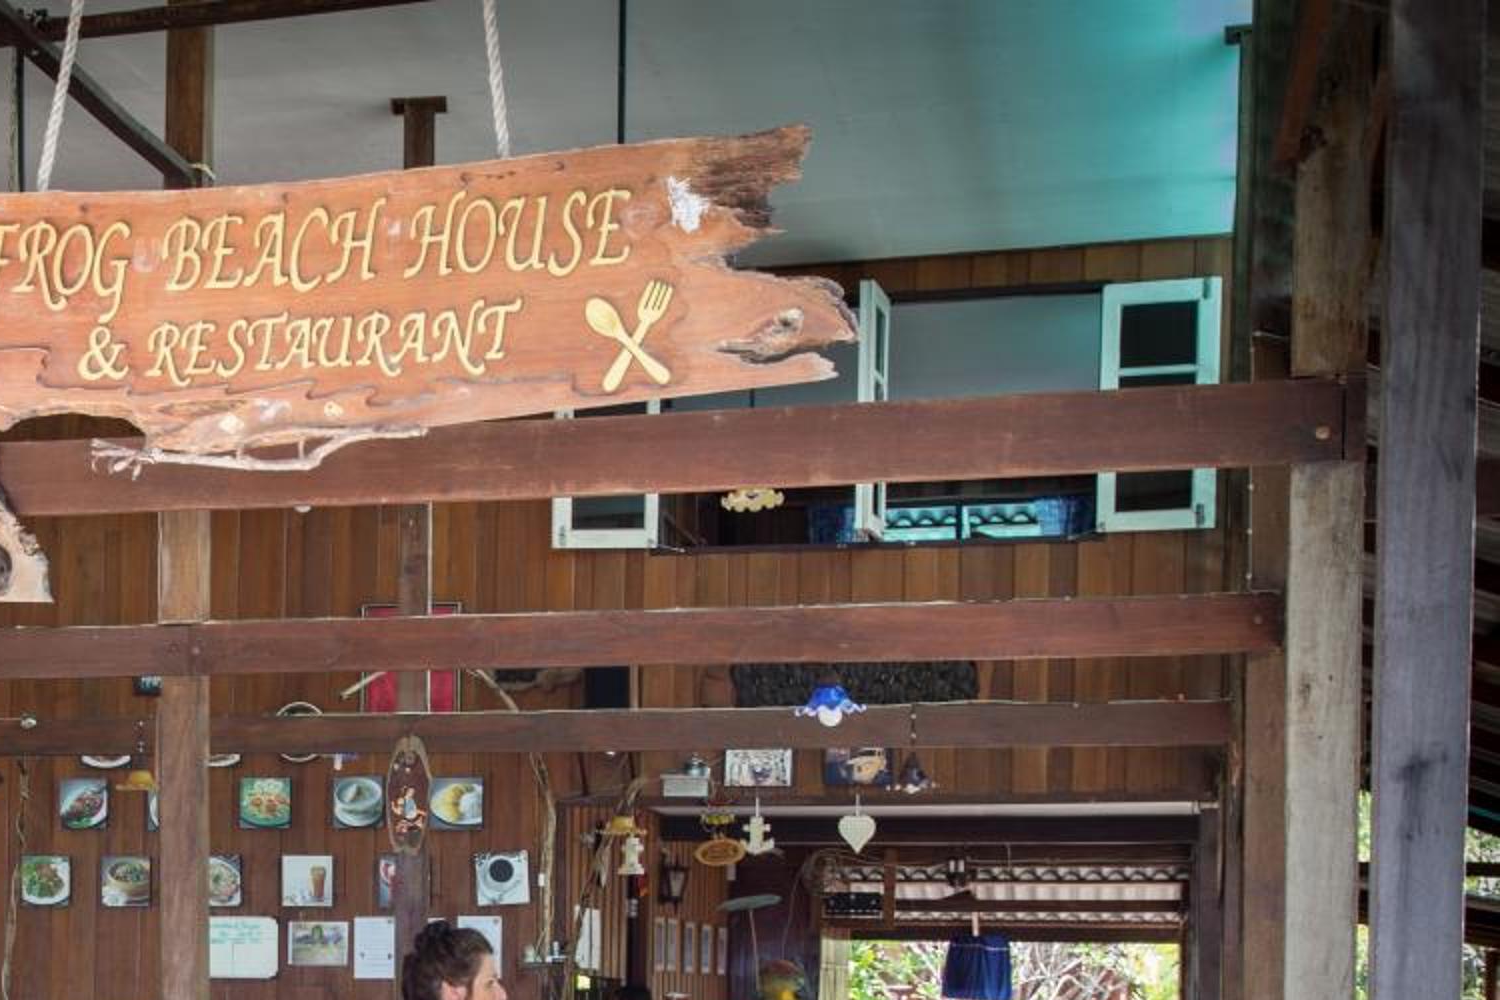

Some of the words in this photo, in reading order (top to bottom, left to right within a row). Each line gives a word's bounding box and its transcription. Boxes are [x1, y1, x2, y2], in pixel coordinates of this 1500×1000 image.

[161, 197, 387, 293] BEACH
[403, 190, 631, 277] HOUSE
[77, 326, 130, 381] &
[144, 300, 523, 386] RESTAURANT
